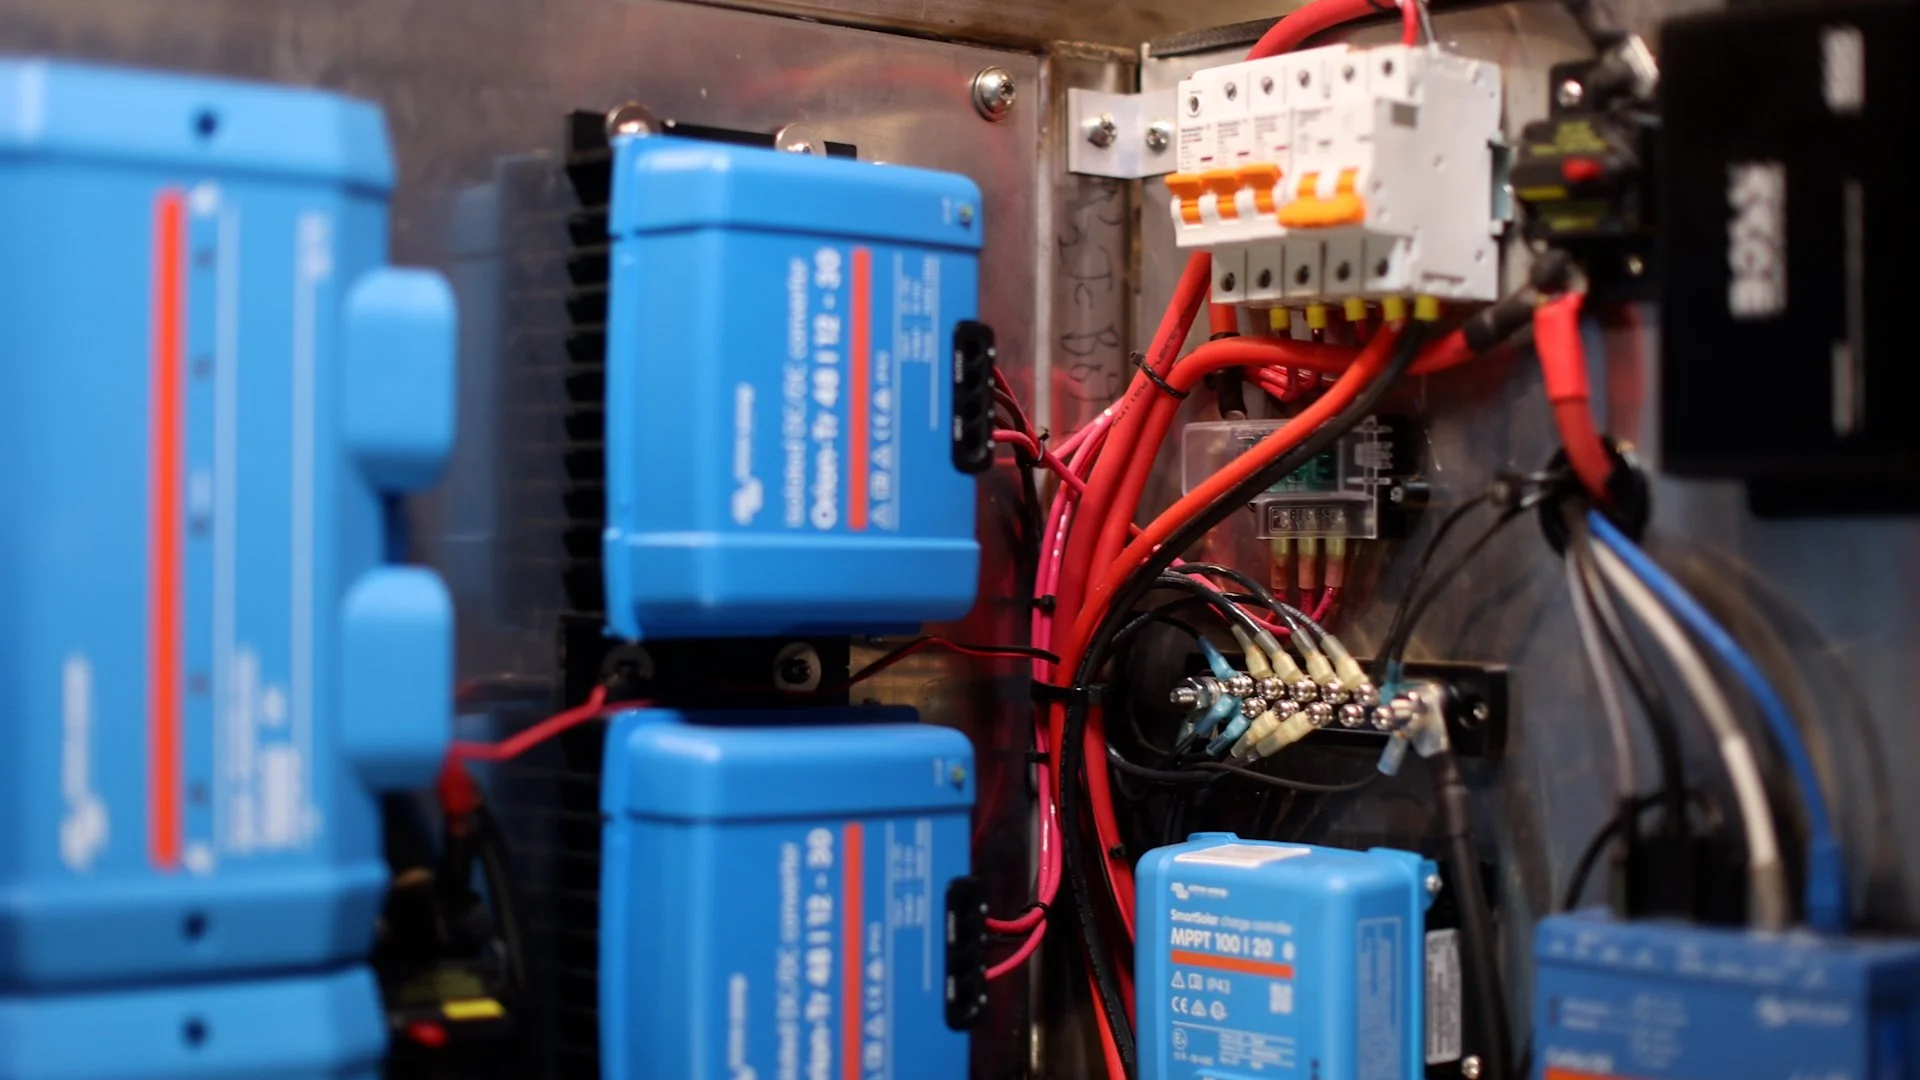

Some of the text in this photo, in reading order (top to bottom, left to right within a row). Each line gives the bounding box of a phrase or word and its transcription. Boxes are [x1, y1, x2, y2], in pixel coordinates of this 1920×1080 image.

[813, 246, 842, 290] 30
[786, 256, 809, 361] converter
[812, 312, 841, 347] 12
[782, 362, 808, 438] DC/DC
[812, 367, 840, 410] 48
[811, 413, 839, 530] Orion-Tr
[806, 827, 834, 869] 30
[806, 893, 834, 928] 12
[1170, 908, 1219, 926] SmartSolar
[1170, 926, 1212, 950] MPPT
[1214, 932, 1241, 955] 100
[1252, 937, 1274, 959] 20
[806, 947, 833, 988] 48
[805, 990, 833, 1080] rion-Tr
